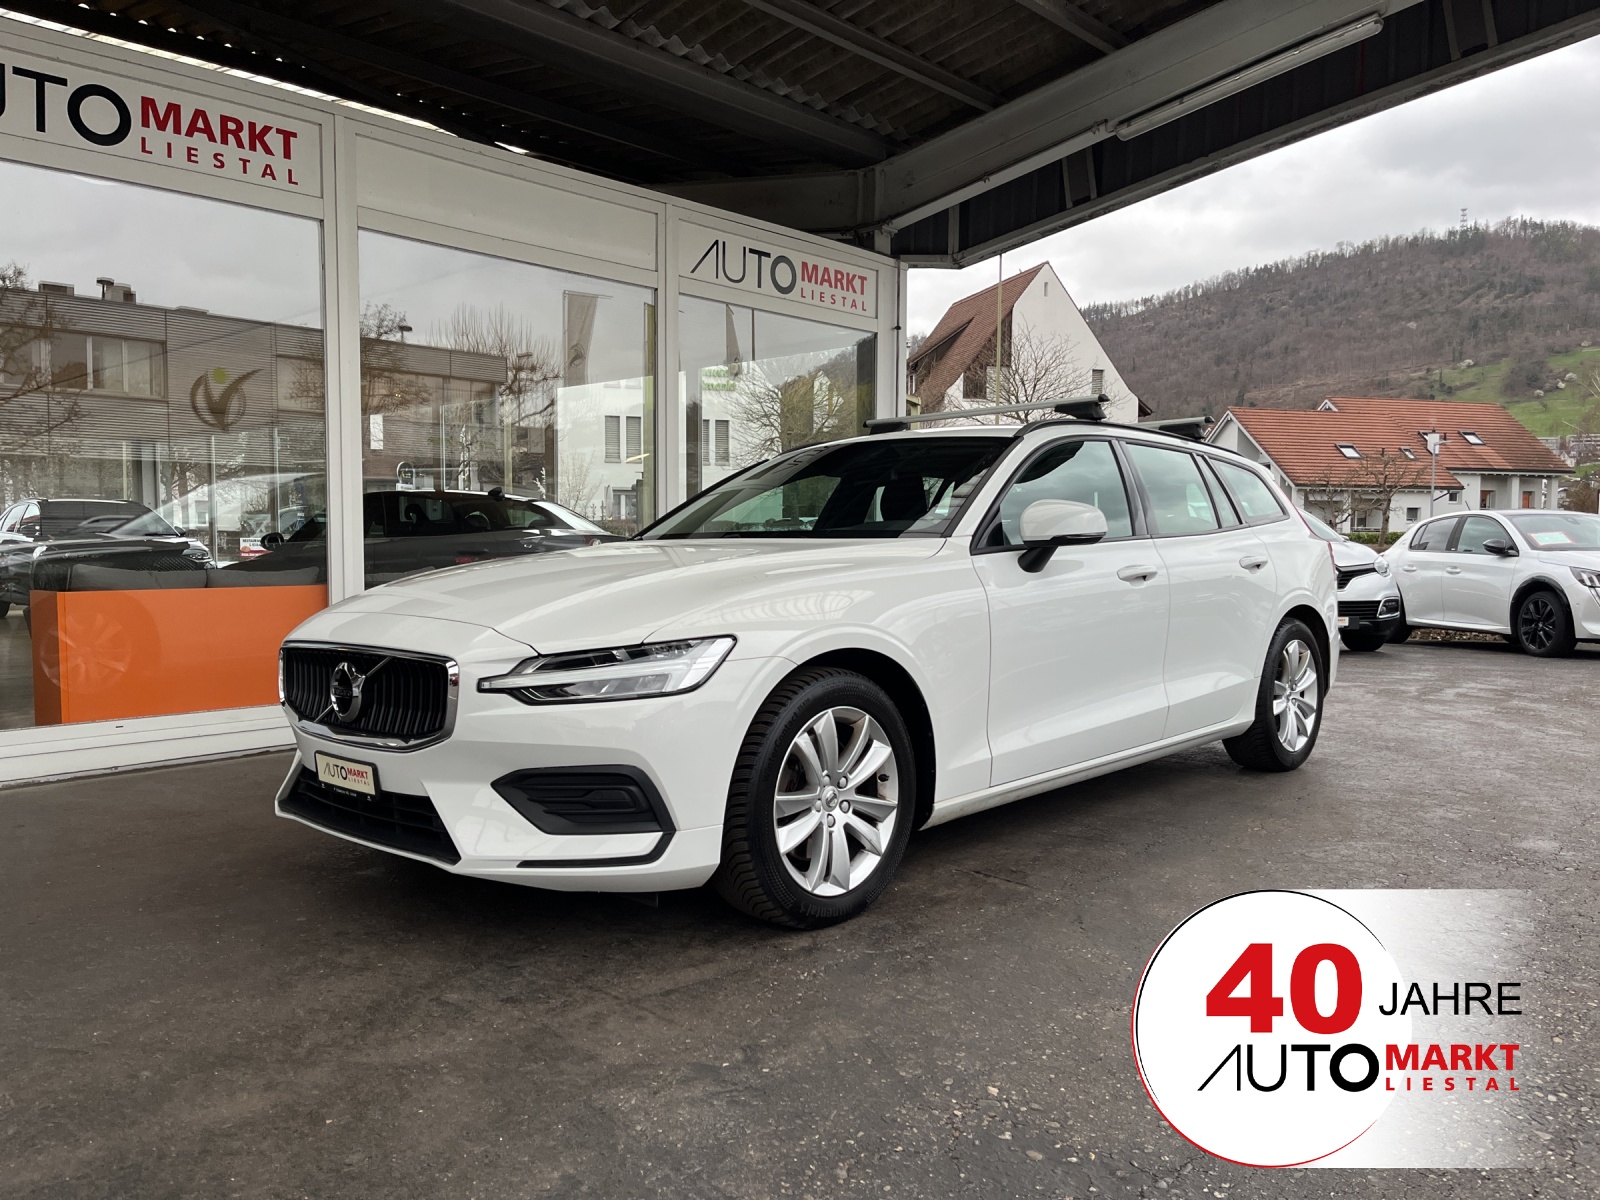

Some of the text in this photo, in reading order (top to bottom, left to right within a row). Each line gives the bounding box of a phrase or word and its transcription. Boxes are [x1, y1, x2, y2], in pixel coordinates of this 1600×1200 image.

[140, 95, 298, 161] MARKT
[140, 136, 299, 186] LIESTAL
[690, 239, 868, 296] AUTO MARKT
[800, 287, 867, 312] LIESTAL
[347, 767, 369, 780] MARKT
